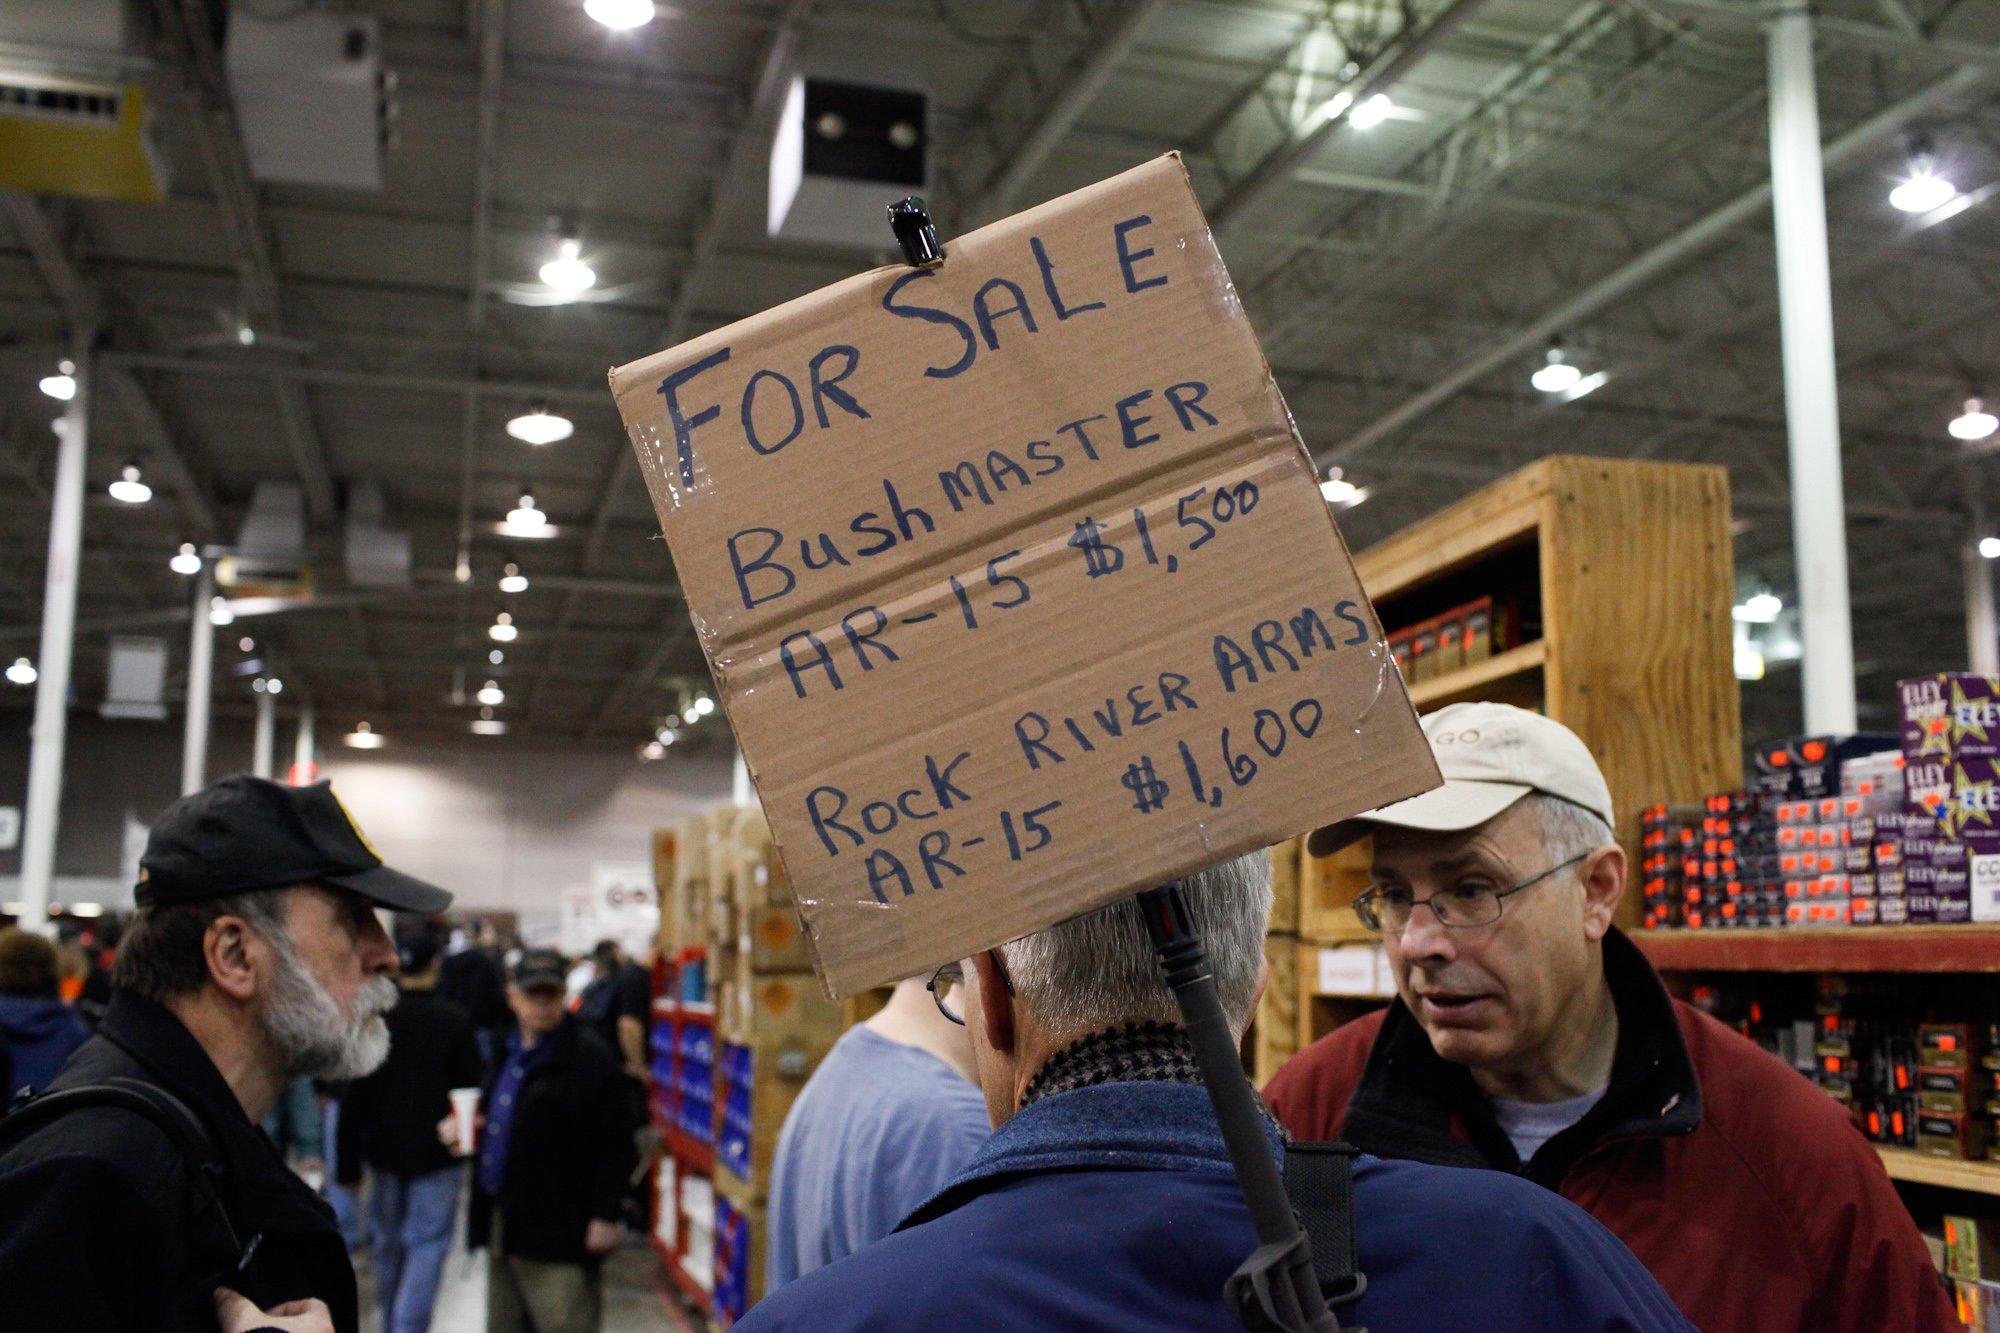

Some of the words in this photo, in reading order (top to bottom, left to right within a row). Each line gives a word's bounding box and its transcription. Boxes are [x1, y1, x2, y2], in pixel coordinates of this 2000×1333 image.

[657, 345, 872, 488] FOR
[881, 214, 1170, 379] SALE
[779, 550, 1031, 698] AR-15
[1068, 480, 1260, 578] $1,500
[1014, 671, 1198, 769] RIVER
[1213, 600, 1369, 692] ARMS
[865, 801, 1062, 903] AR-15
[1122, 699, 1322, 814] $1,600
[1955, 702, 2000, 728] ELE
